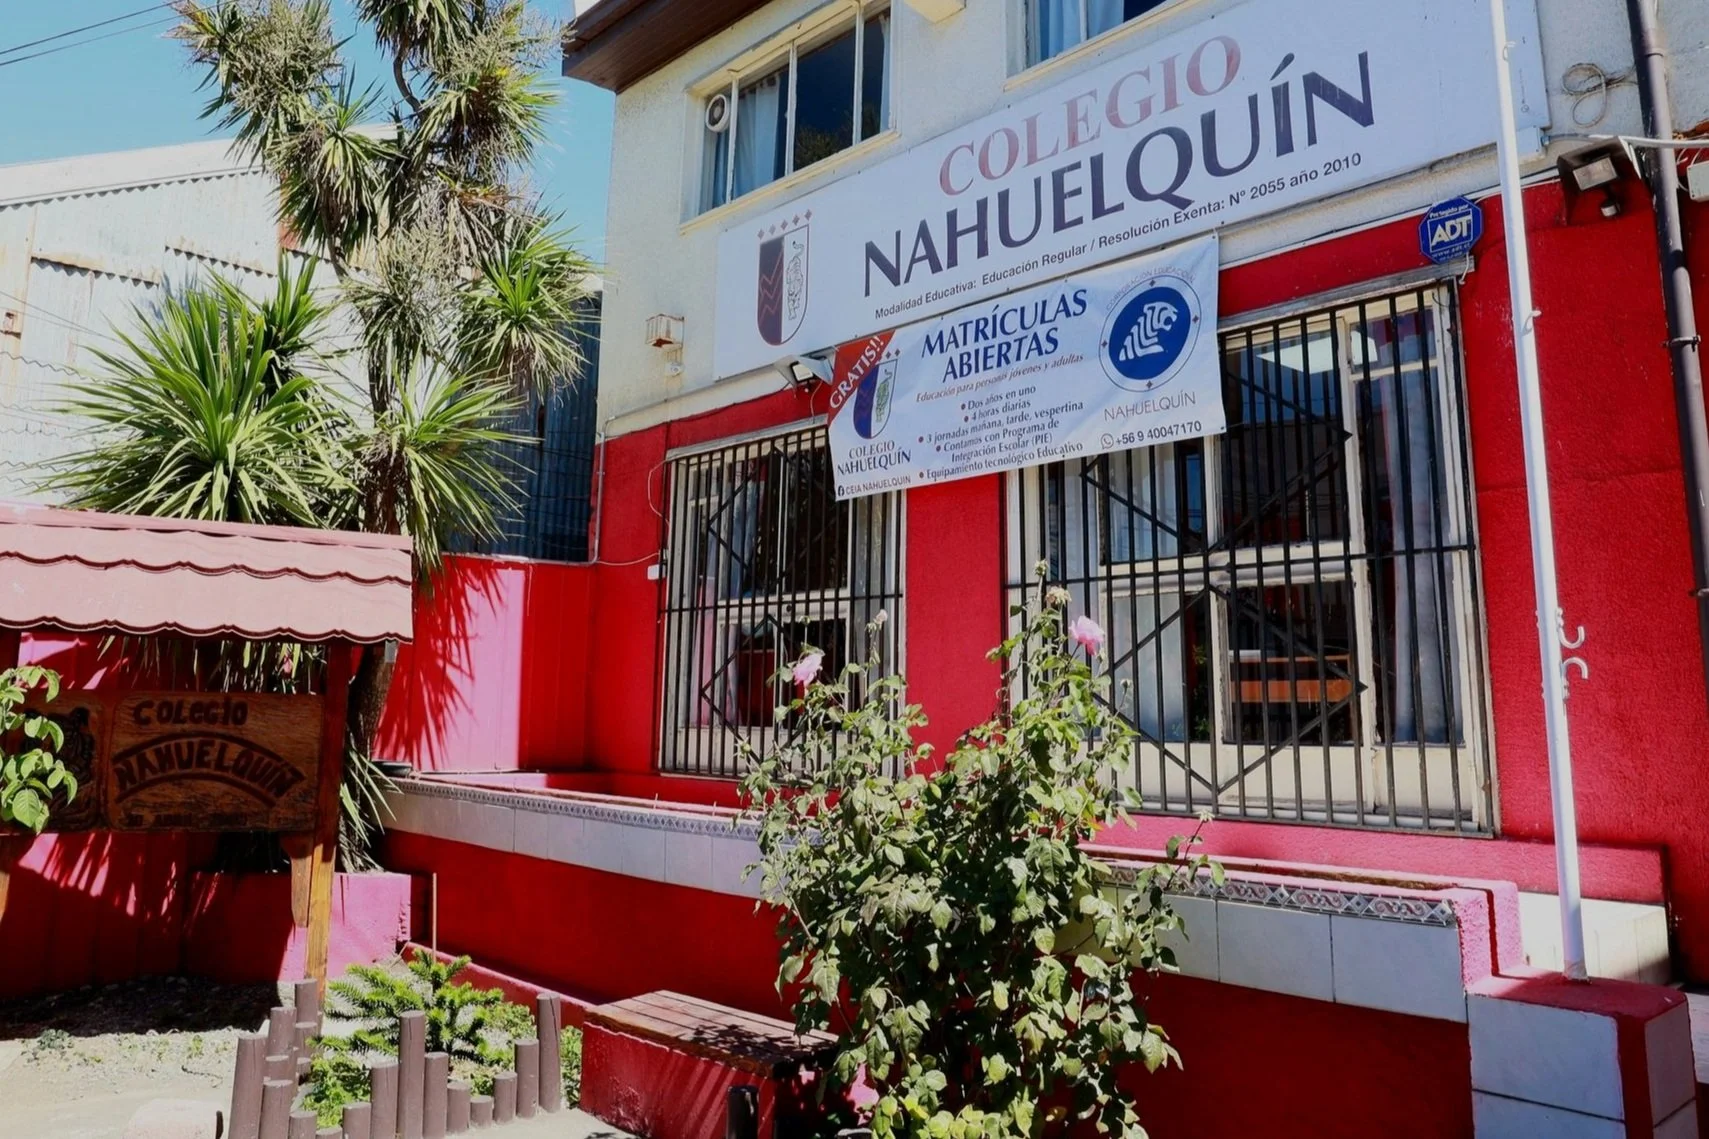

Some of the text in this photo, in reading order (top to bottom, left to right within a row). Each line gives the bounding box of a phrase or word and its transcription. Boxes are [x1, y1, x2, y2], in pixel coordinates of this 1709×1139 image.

[939, 36, 1241, 197] COLEGIO
[864, 51, 1375, 297] NAHUELQUÍN
[875, 293, 923, 319] Modalidad
[925, 279, 977, 303] Educativa:
[982, 256, 1039, 285] Educación
[1042, 243, 1087, 267] Regular
[1098, 215, 1170, 249] Resolución
[1174, 200, 1225, 225] Exenta:
[1250, 177, 1285, 200] 2055
[1290, 169, 1319, 187] año
[1323, 152, 1362, 176] 2010
[1431, 214, 1471, 246] ADT
[921, 289, 1088, 358] MATRÍCULAS
[829, 335, 884, 409] GRATIS!!
[942, 327, 1059, 383] ABIERTAS
[916, 354, 1084, 402] Educación para personas jóvenes y adultas
[967, 386, 1037, 411] Dos años en uno
[971, 400, 1032, 421] 4 horas diarias
[1104, 390, 1196, 421] NAHUELQUÍN
[934, 426, 969, 445] jornadas
[970, 419, 1004, 435] mañana,
[1006, 411, 1032, 425] tarde,
[1034, 401, 1084, 420] vespertina
[943, 418, 1060, 452] Contamos con Programa de
[1115, 420, 1202, 446] +56 9 40047170
[837, 447, 912, 476] NAHUELQUÍN
[848, 439, 895, 460] COLEGIO
[926, 441, 1084, 482] Equipamiento tecnológico Educativo
[951, 432, 1053, 463] Integración Escolar (PIE)
[846, 474, 911, 496] CEIA NAHUELQUIN
